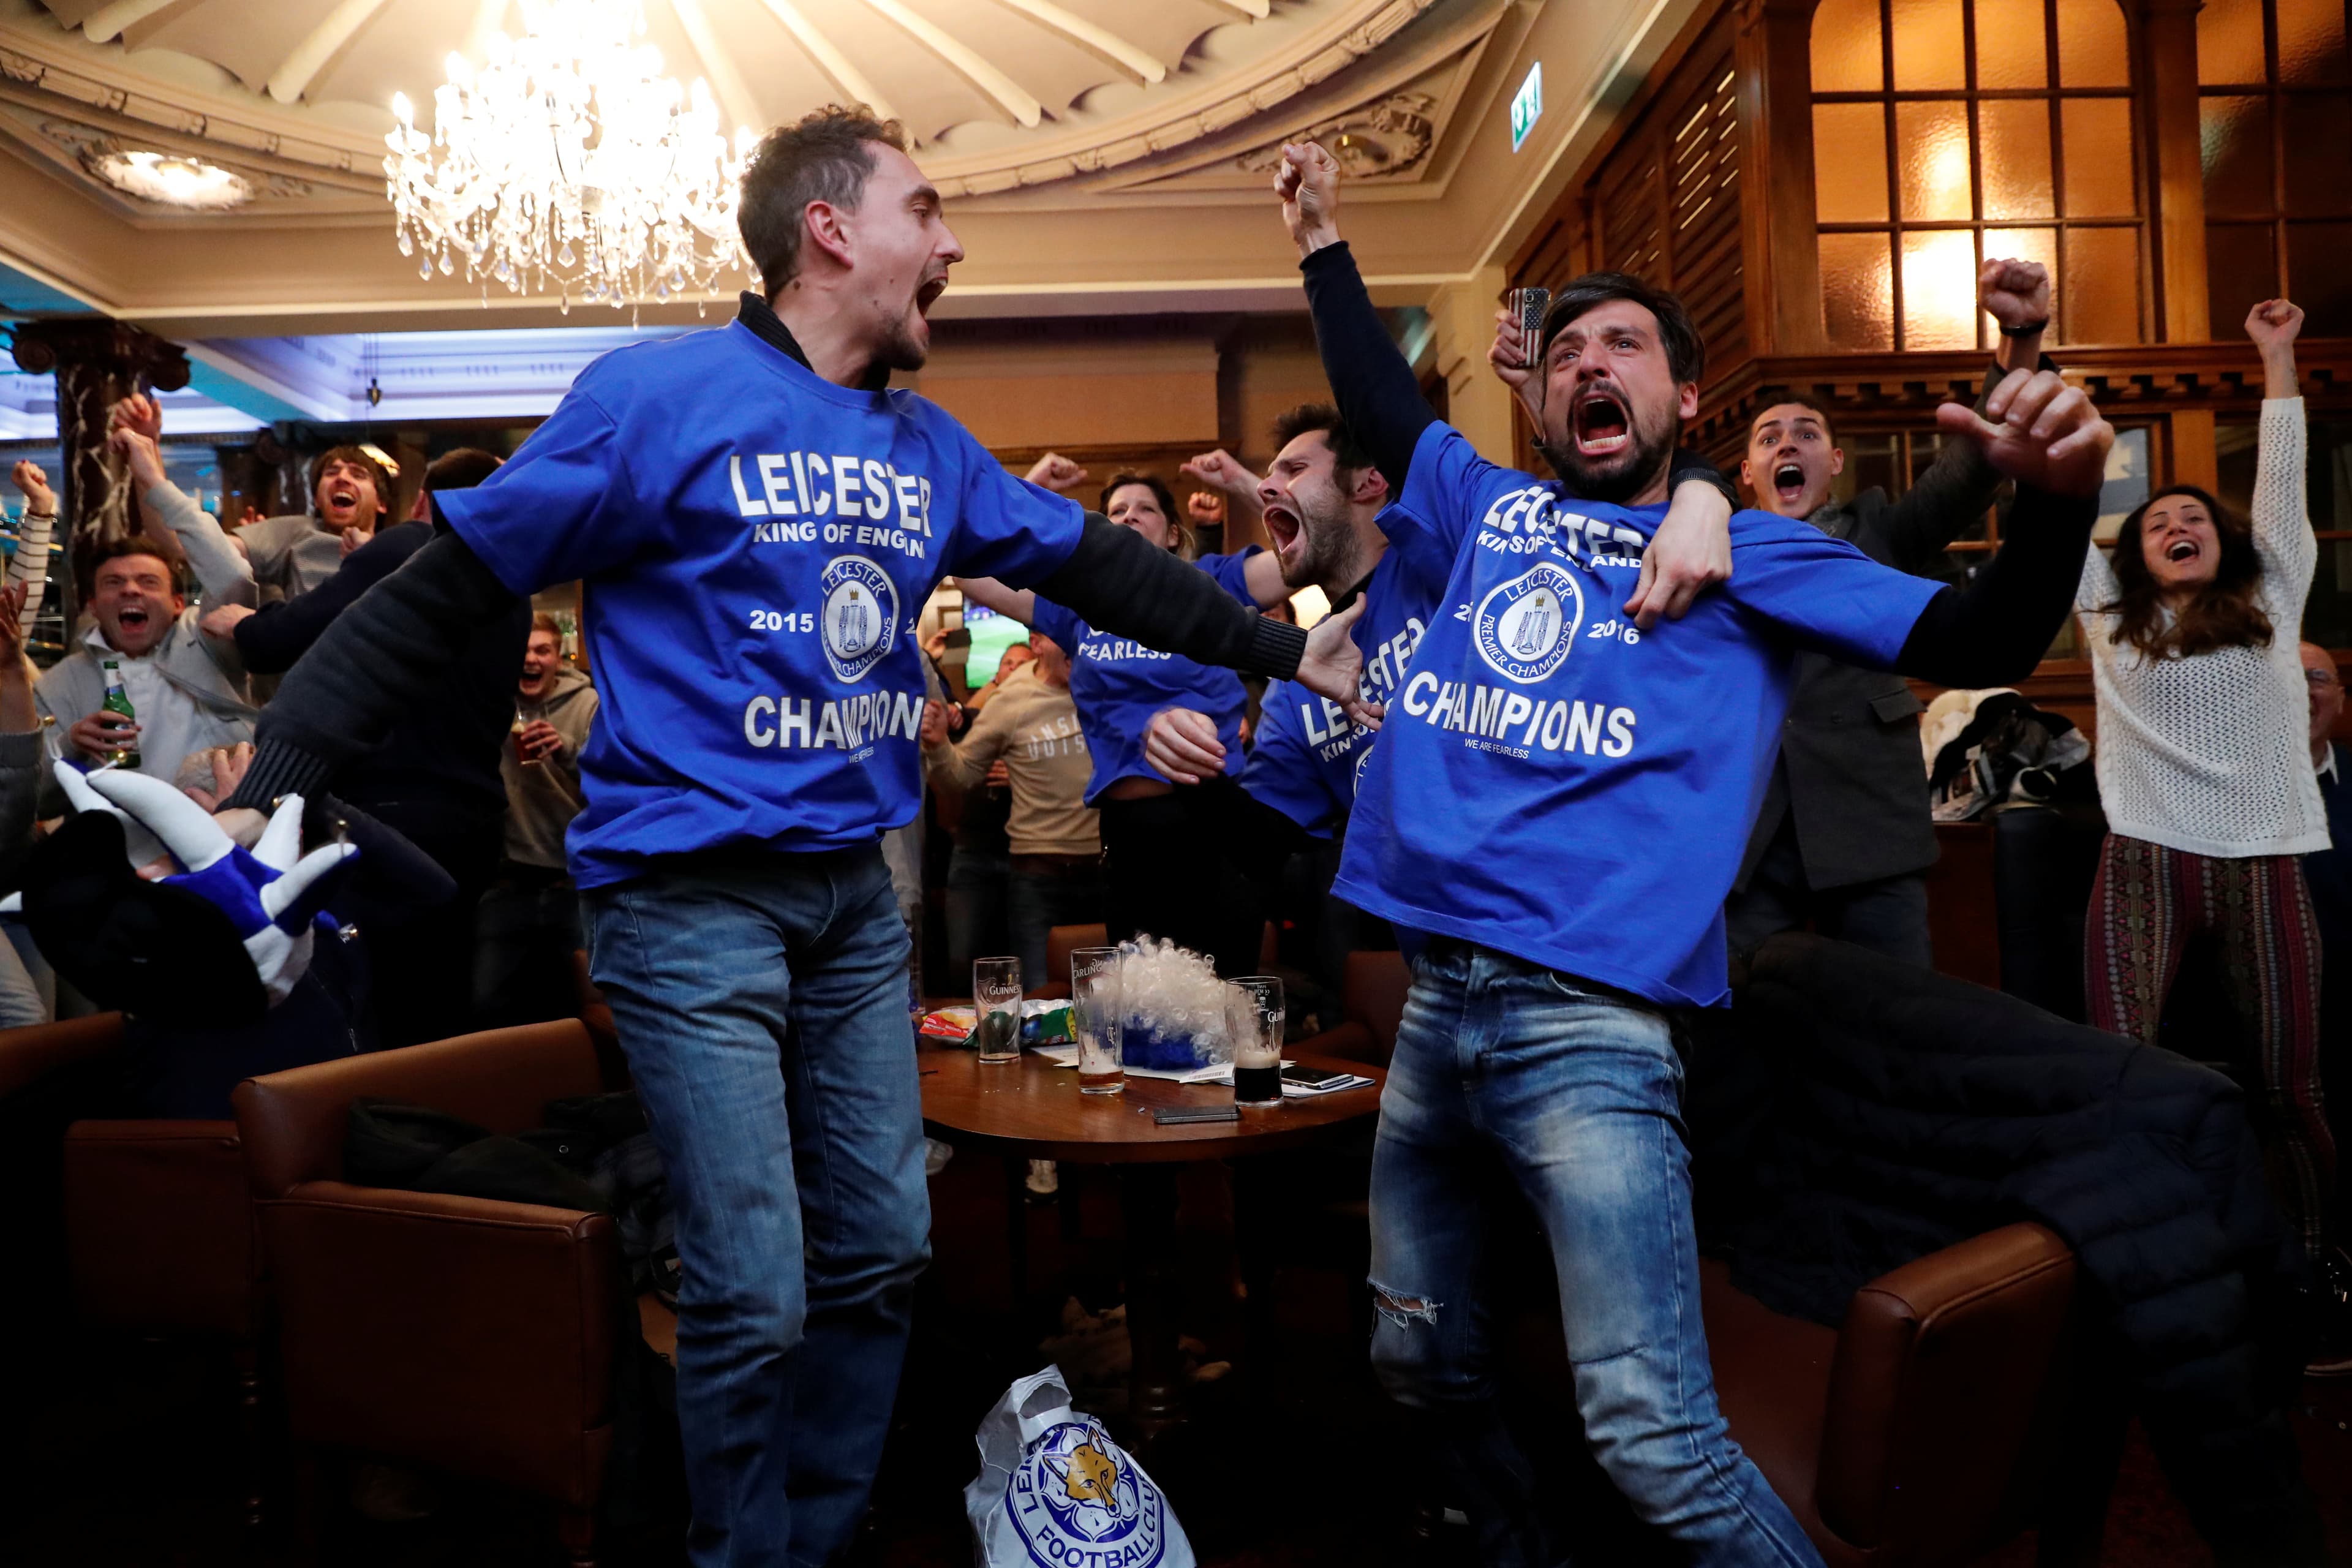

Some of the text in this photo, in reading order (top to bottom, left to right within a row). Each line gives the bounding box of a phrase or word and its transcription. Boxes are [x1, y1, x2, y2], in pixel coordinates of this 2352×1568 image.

[753, 521, 817, 543] KING
[823, 523, 851, 543] OF
[1525, 535, 1548, 555] OF
[822, 562, 887, 598] LEICESTER
[1504, 569, 1574, 602] LEICESTER
[750, 609, 815, 633] 2015
[1587, 619, 1640, 644] 2016
[842, 616, 892, 676] CHAMPIONS
[1480, 613, 1572, 677] PREMIER CHAMPIONS
[1403, 671, 1636, 758] CHAMPIONS
[1464, 738, 1529, 760] WE ARE FEARLESS
[1139, 1475, 1155, 1532] CLU
[1036, 1524, 1155, 1568] FOOTBALL
